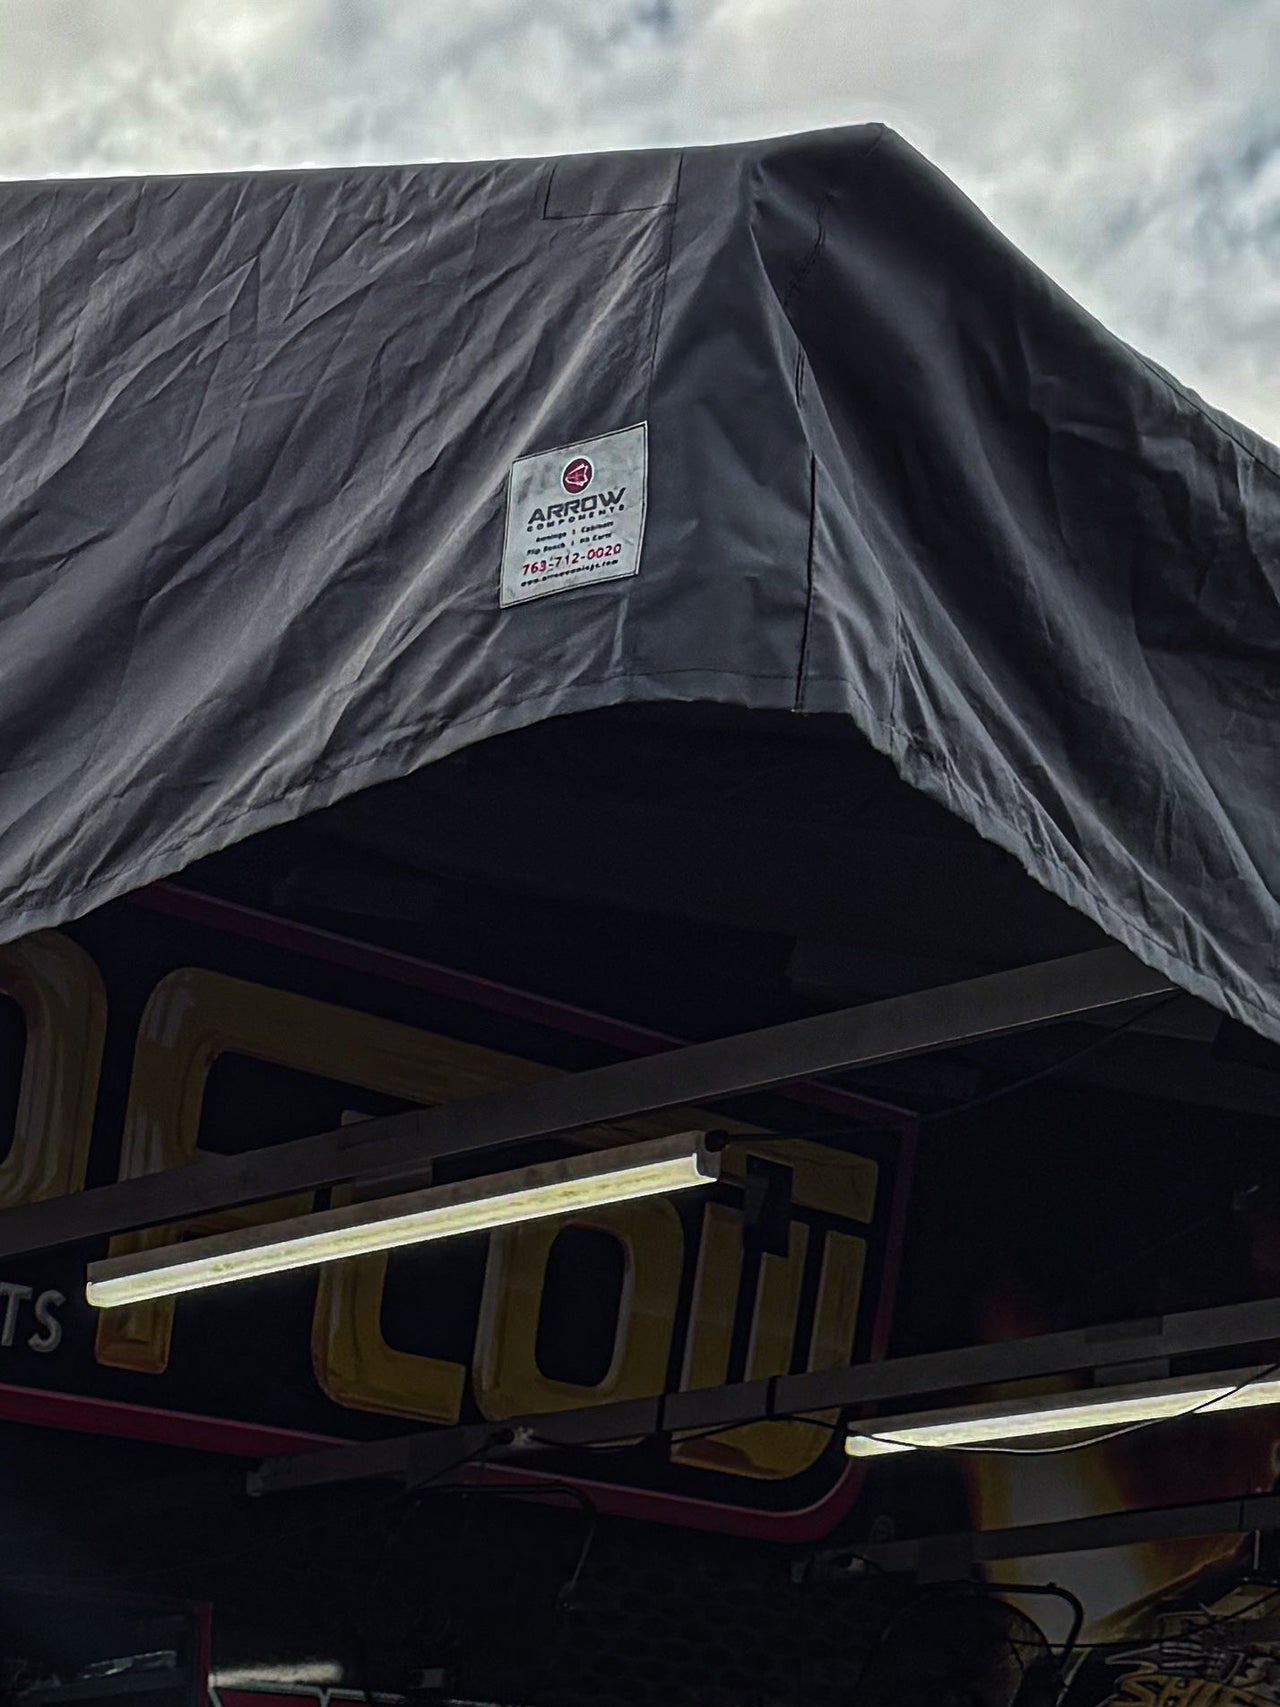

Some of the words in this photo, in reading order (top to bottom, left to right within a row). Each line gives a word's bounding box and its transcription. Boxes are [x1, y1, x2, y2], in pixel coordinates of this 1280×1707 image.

[526, 503, 625, 533] COMPONENTS
[527, 487, 627, 525] ARROW
[522, 543, 622, 577] 763-712-0020
